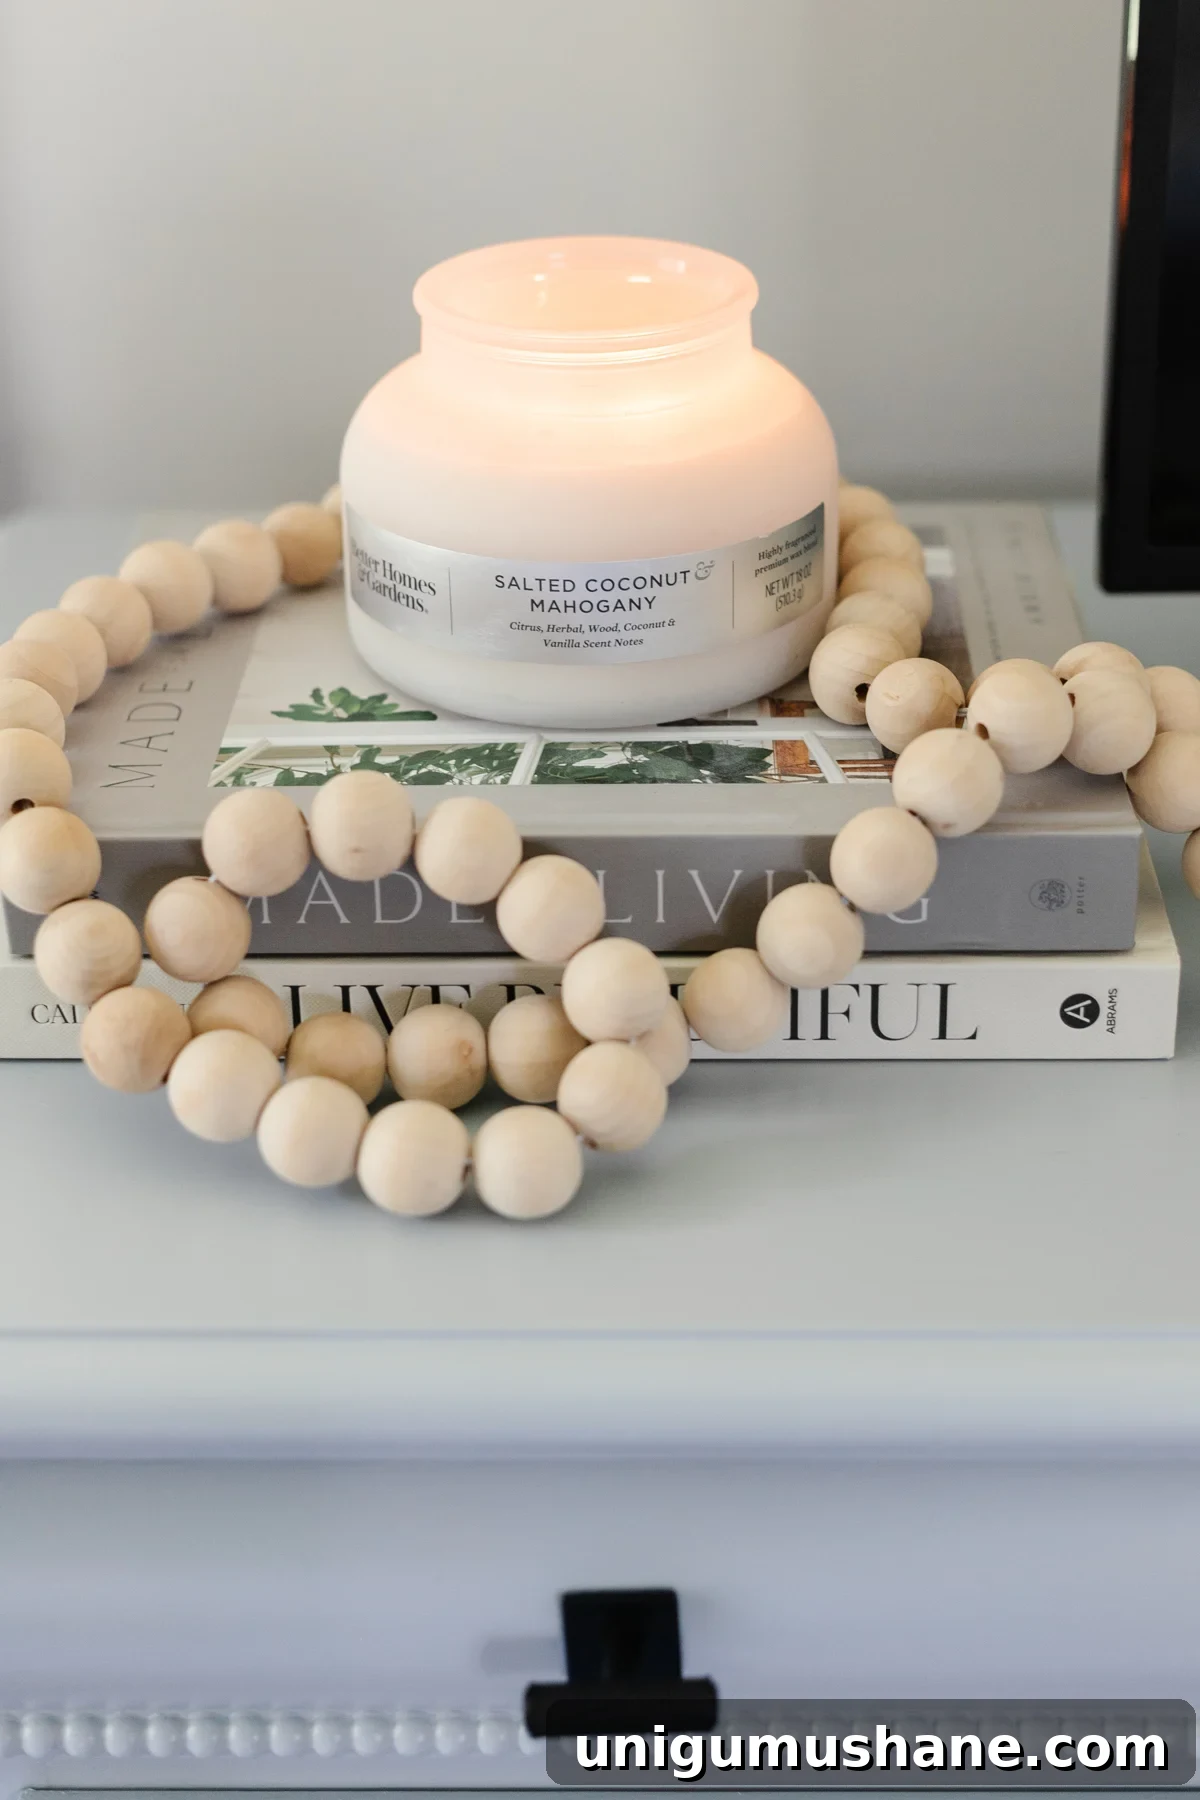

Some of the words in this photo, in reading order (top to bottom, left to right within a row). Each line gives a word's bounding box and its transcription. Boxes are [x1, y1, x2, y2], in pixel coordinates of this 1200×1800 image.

[754, 556, 789, 578] premium
[790, 549, 803, 561] wax
[758, 544, 783, 561] Highly
[382, 559, 437, 597] Homes
[495, 574, 576, 593] SALTED
[585, 570, 691, 592] COCONUT
[694, 560, 716, 581] &
[765, 579, 781, 597] NET
[781, 571, 796, 590] WT
[530, 596, 657, 613] MAHOGANY
[509, 621, 544, 634] Citrus,
[546, 623, 585, 635] Herbal,
[588, 623, 621, 634] Wood,
[623, 620, 666, 632] Coconut
[667, 618, 676, 628] &
[543, 638, 581, 648] Vanilla
[583, 639, 612, 648] Scent
[614, 637, 644, 648] Notes
[100, 680, 194, 789] MADE
[1076, 875, 1086, 915] potter
[1106, 988, 1118, 1035] ABRAMS
